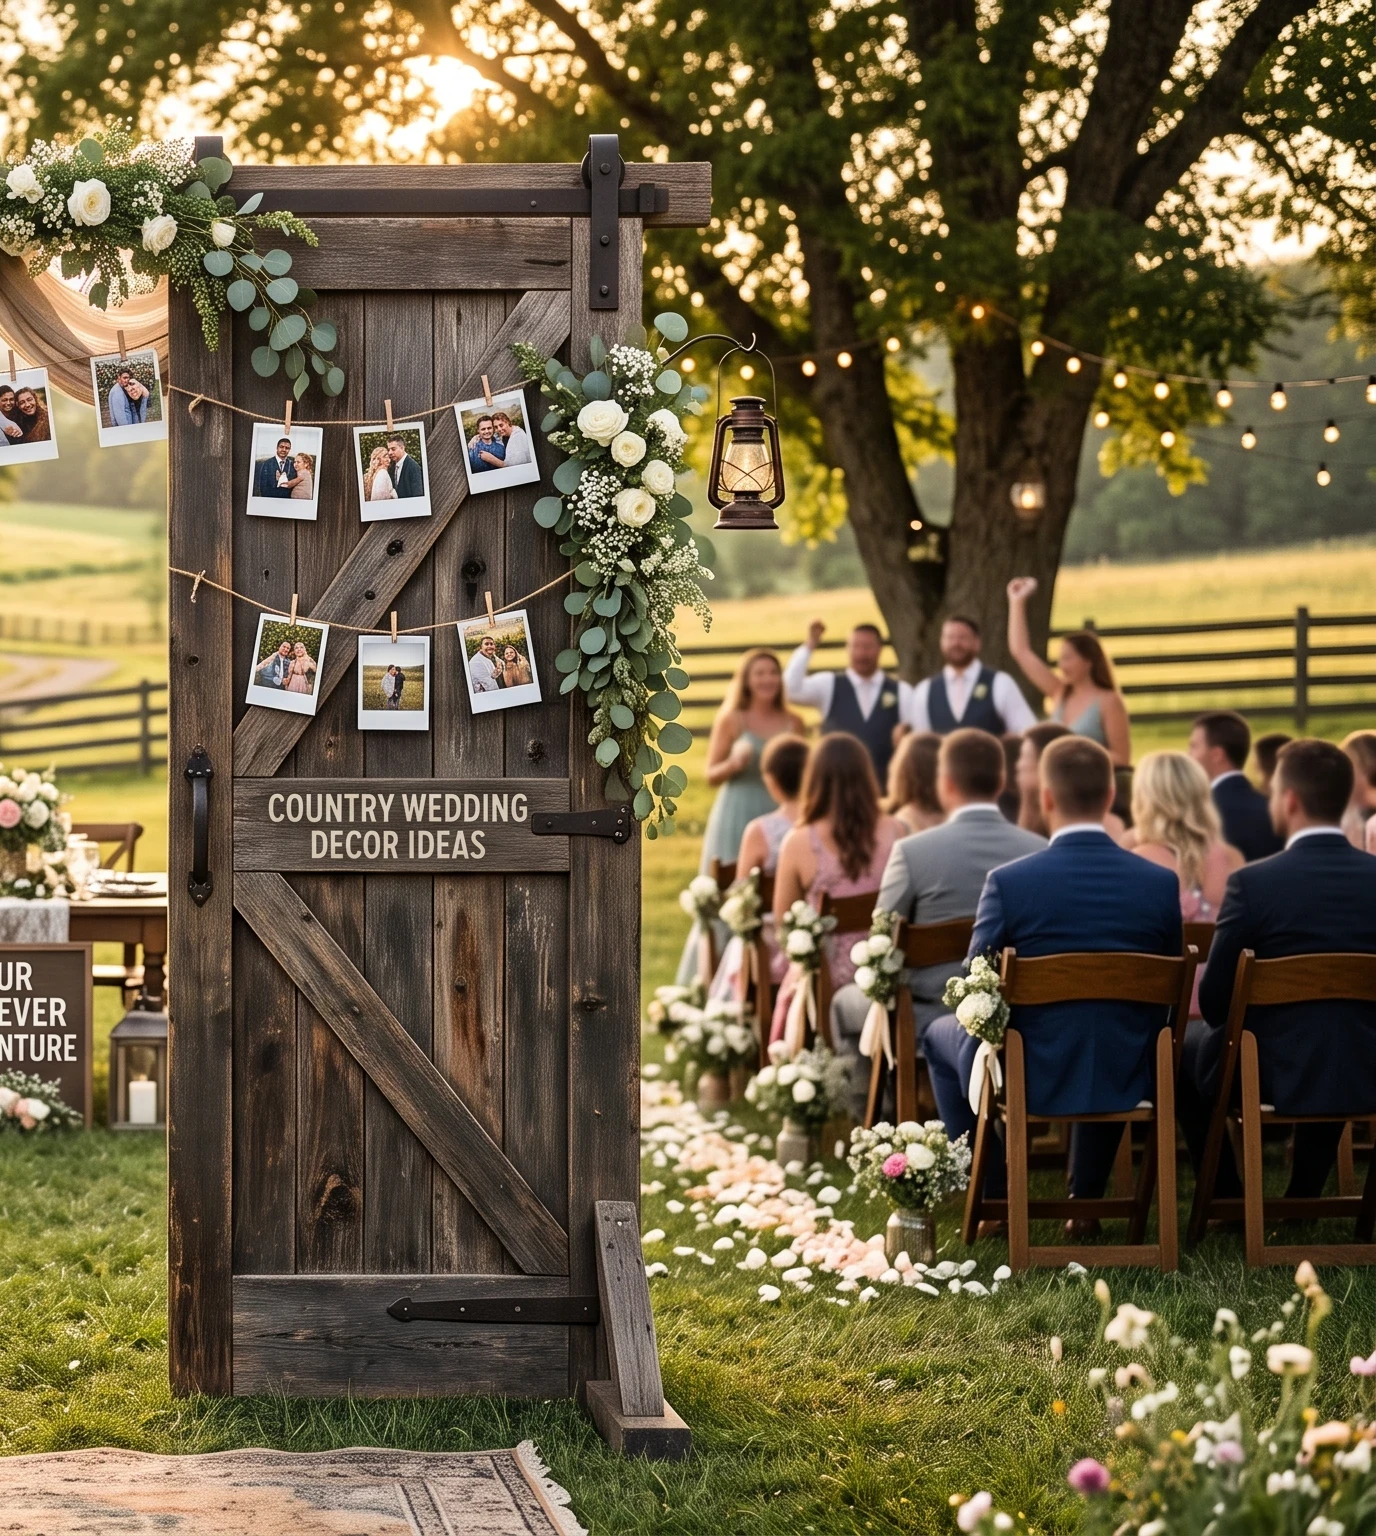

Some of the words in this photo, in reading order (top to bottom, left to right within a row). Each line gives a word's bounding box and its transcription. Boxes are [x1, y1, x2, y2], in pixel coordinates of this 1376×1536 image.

[268, 793, 395, 823] COUNTRY
[401, 793, 528, 823] WEDDING
[311, 830, 399, 859] DECOR
[409, 830, 486, 859] IDEAS
